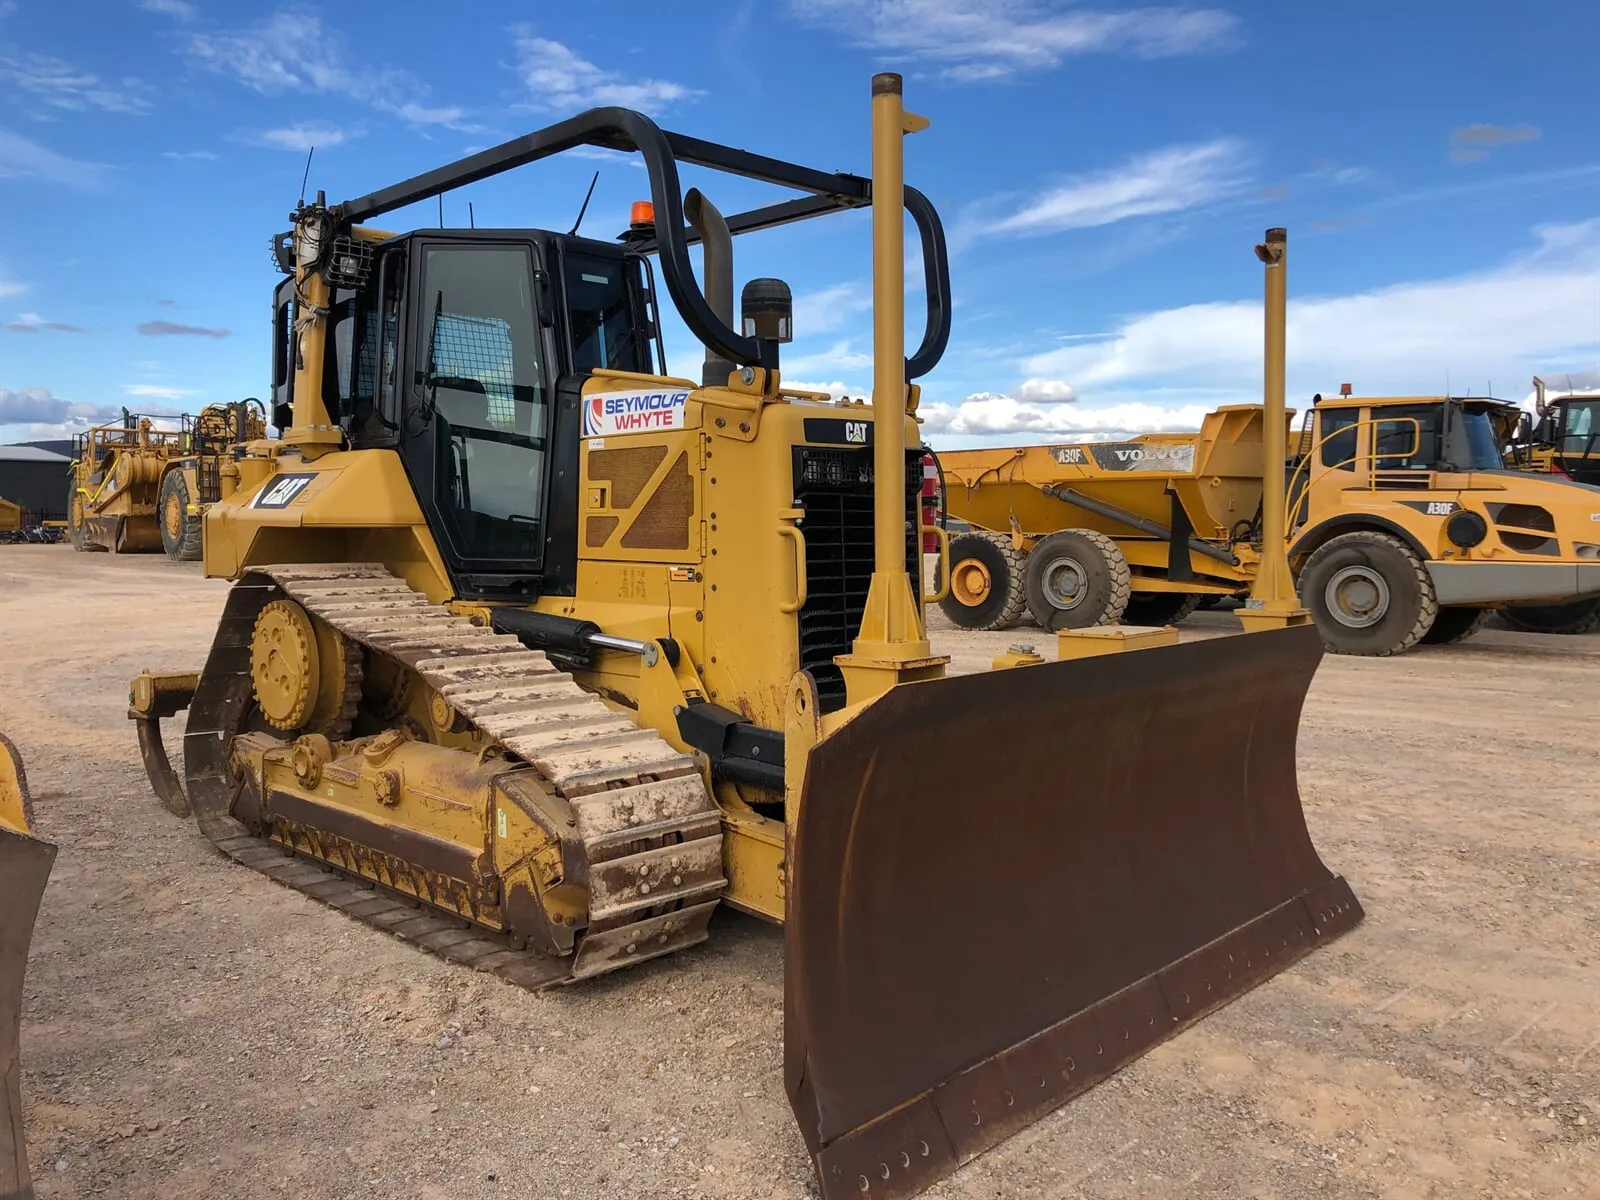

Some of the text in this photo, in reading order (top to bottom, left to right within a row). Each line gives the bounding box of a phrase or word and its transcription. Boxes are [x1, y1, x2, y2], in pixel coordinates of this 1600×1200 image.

[605, 393, 688, 415] SEYMOUR
[615, 410, 673, 430] WHYTE
[845, 422, 867, 442] CAT
[1058, 449, 1081, 463] A30F
[1115, 449, 1183, 462] VOLVO
[261, 478, 310, 505] CAT
[1427, 502, 1454, 515] A30F
